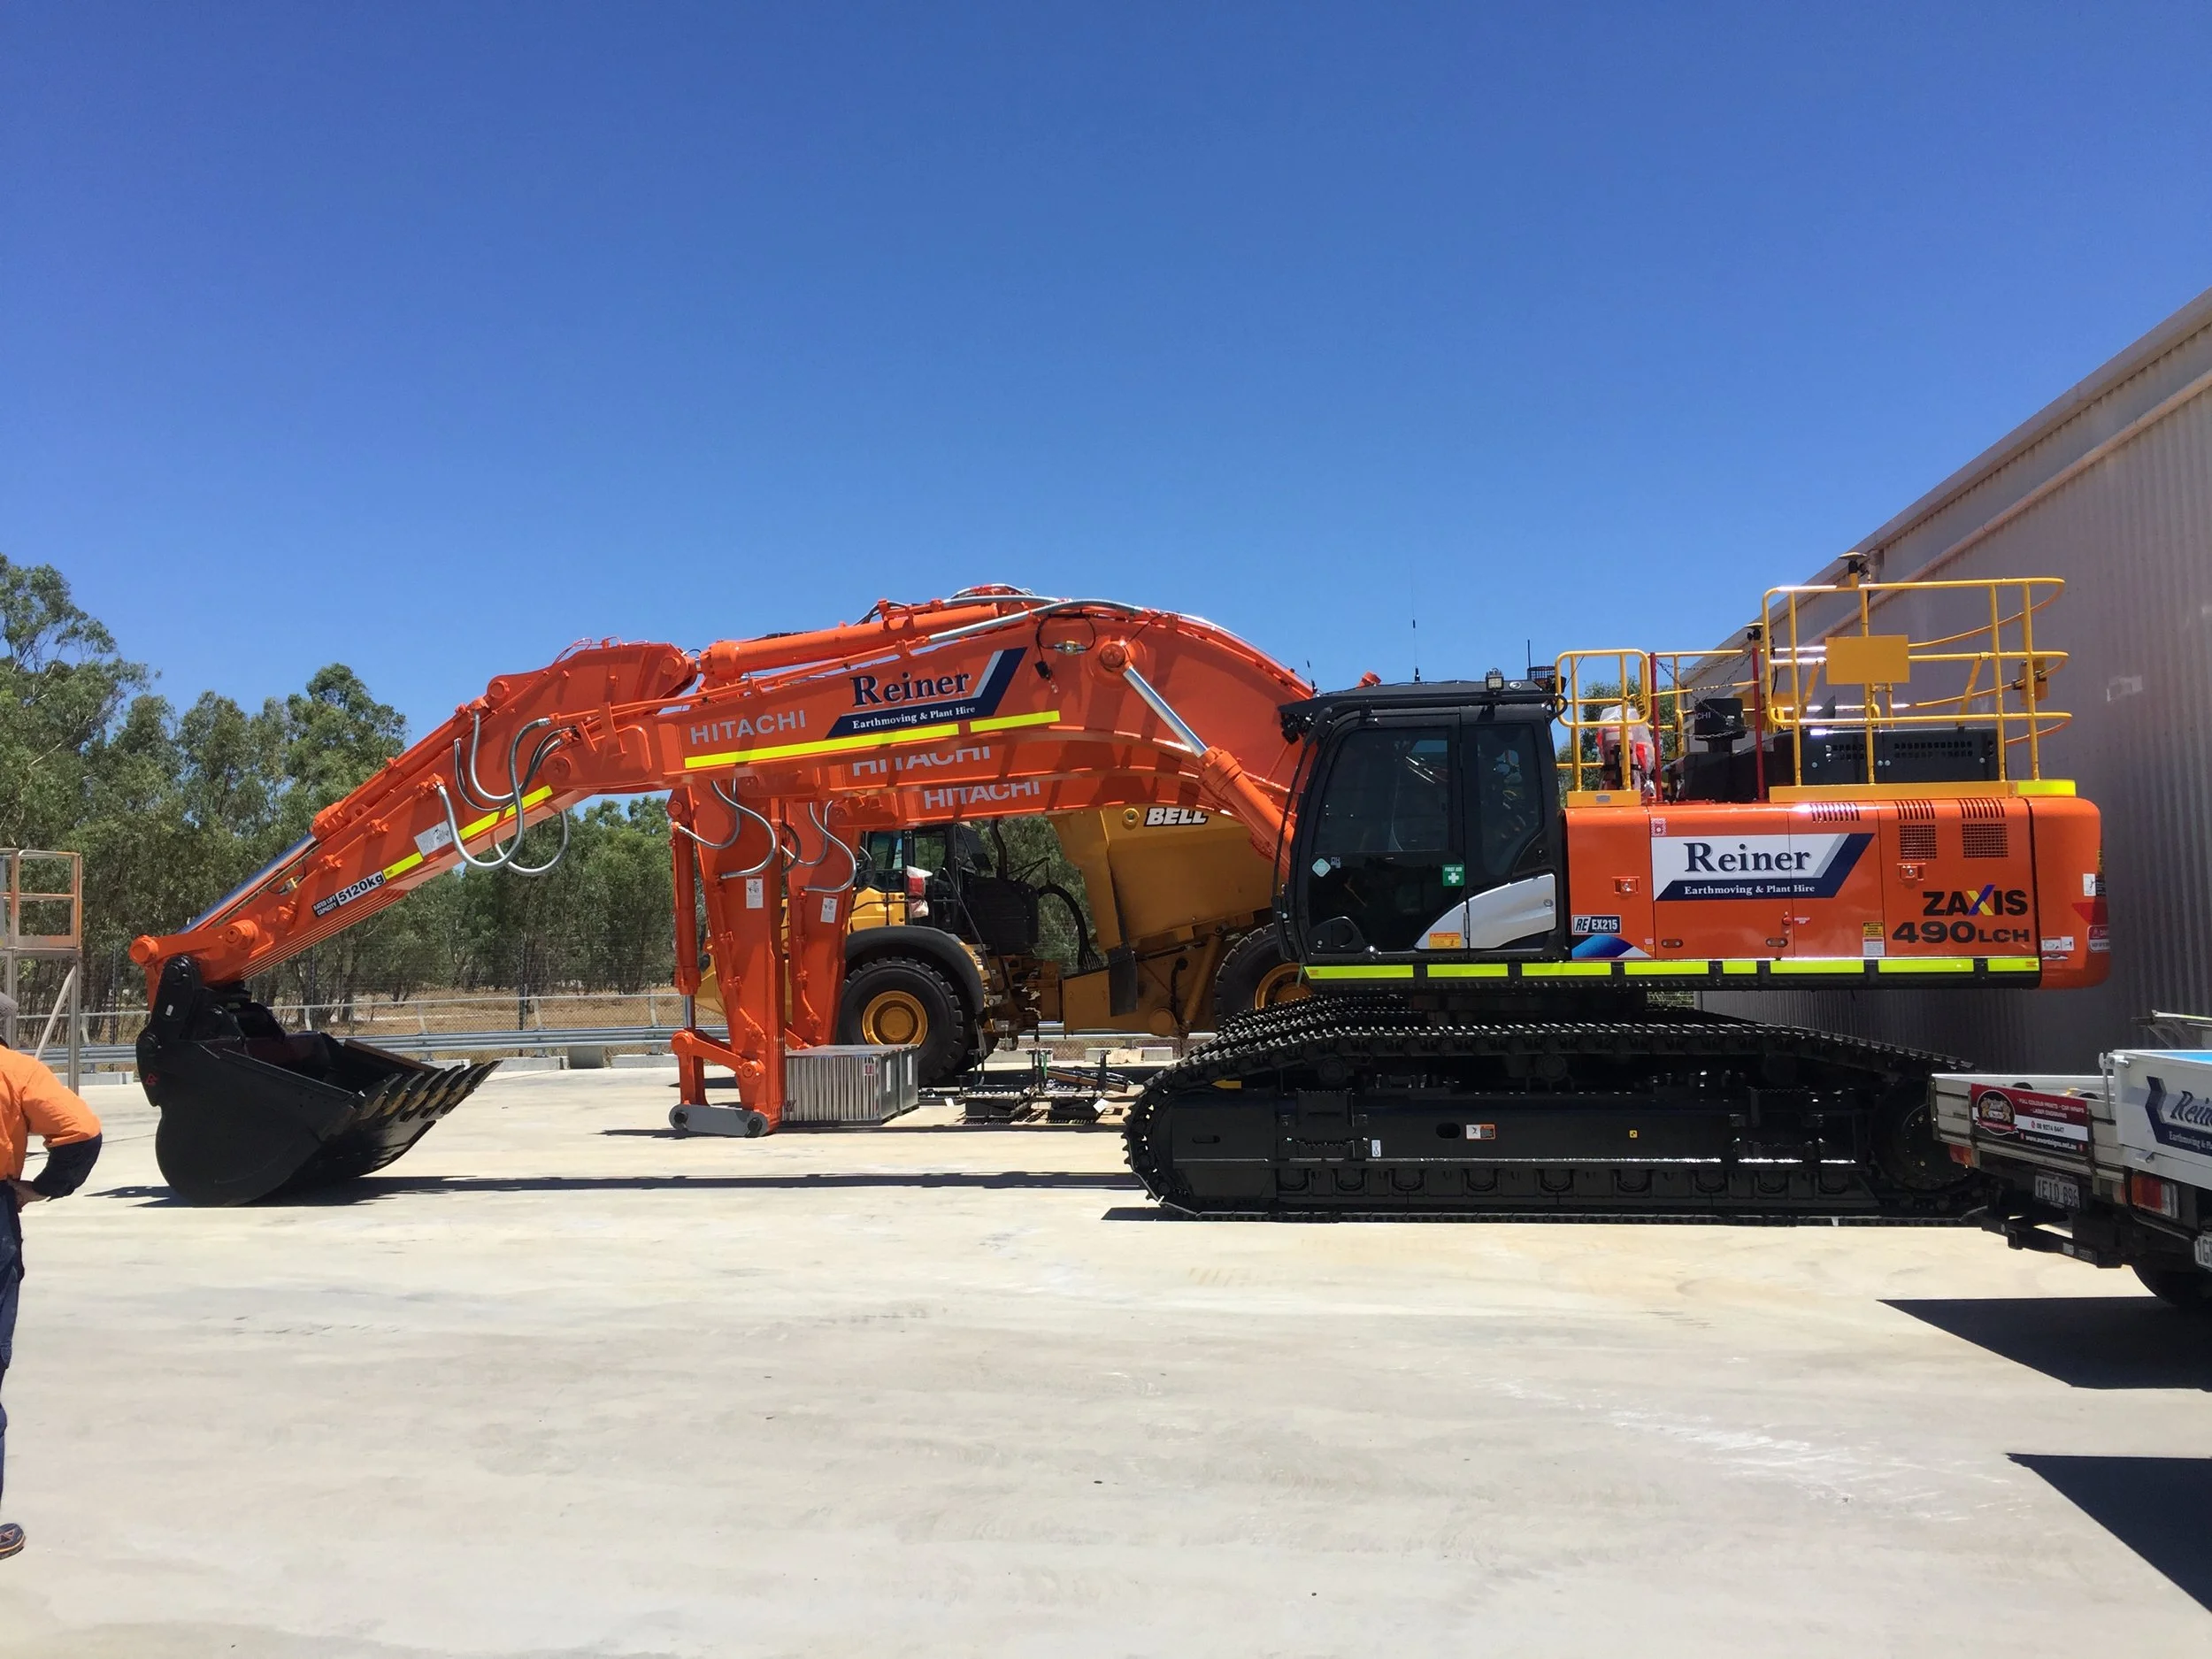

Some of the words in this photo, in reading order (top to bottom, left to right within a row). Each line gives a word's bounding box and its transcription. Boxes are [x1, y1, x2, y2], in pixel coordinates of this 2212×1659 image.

[849, 672, 972, 707] Reiner
[690, 710, 806, 745] HITACHI
[852, 713, 917, 730] Earthmoving
[919, 710, 928, 721] &
[930, 708, 954, 719] Plant
[956, 705, 975, 715] Hire
[924, 781, 1041, 810] HITACHI
[1146, 807, 1208, 826] BELL
[1683, 842, 1812, 872] Reiner
[338, 874, 384, 902] 5120kg
[1684, 886, 1753, 896] Earthmoving
[1755, 885, 1763, 894] &
[1766, 885, 1790, 894] Plant
[1923, 884, 2028, 916] ZAXIS
[317, 902, 337, 916] CAPACITY
[1576, 918, 1590, 931] RE
[1592, 919, 1617, 930] EX215
[1892, 921, 2030, 943] 490LCH
